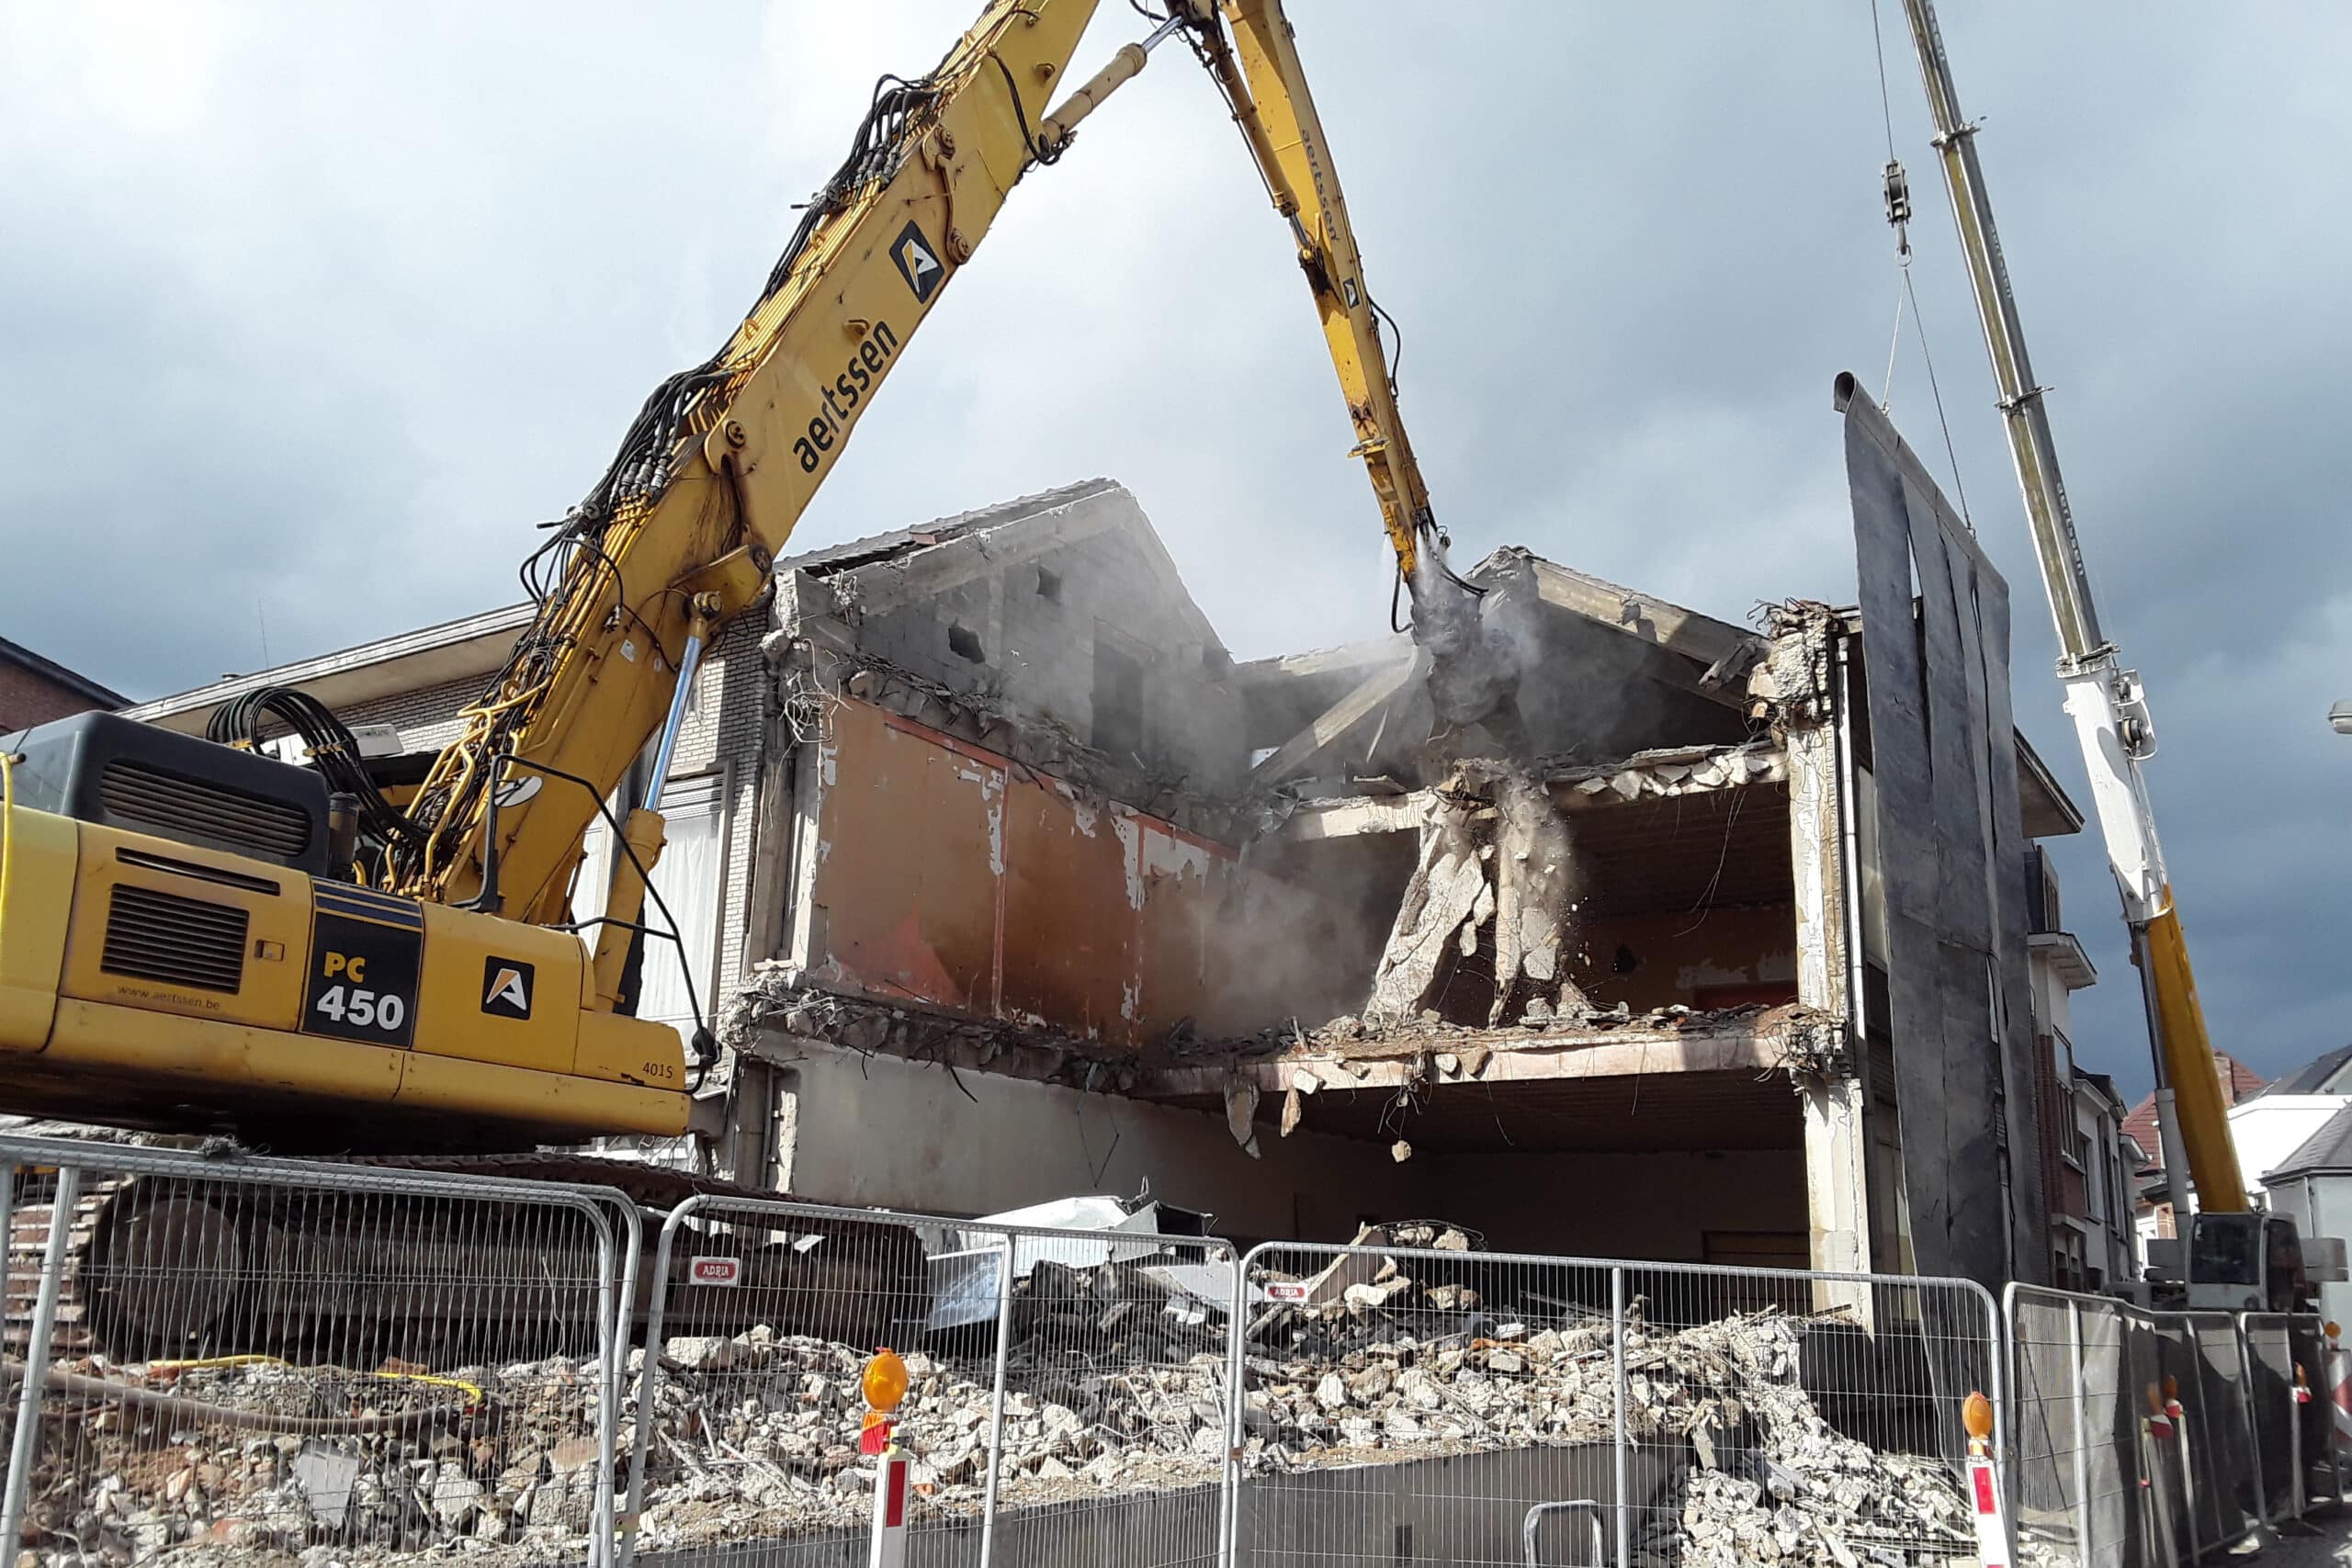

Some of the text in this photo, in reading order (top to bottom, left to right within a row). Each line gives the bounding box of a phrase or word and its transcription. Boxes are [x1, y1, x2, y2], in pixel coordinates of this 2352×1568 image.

[1302, 130, 1340, 240] aertssen
[793, 321, 899, 473] aertssen
[323, 951, 366, 983] PC
[118, 986, 220, 1010] www.aertssen.be
[317, 985, 404, 1030] 450
[642, 1062, 673, 1079] 4015
[703, 1265, 729, 1278] ADRIA
